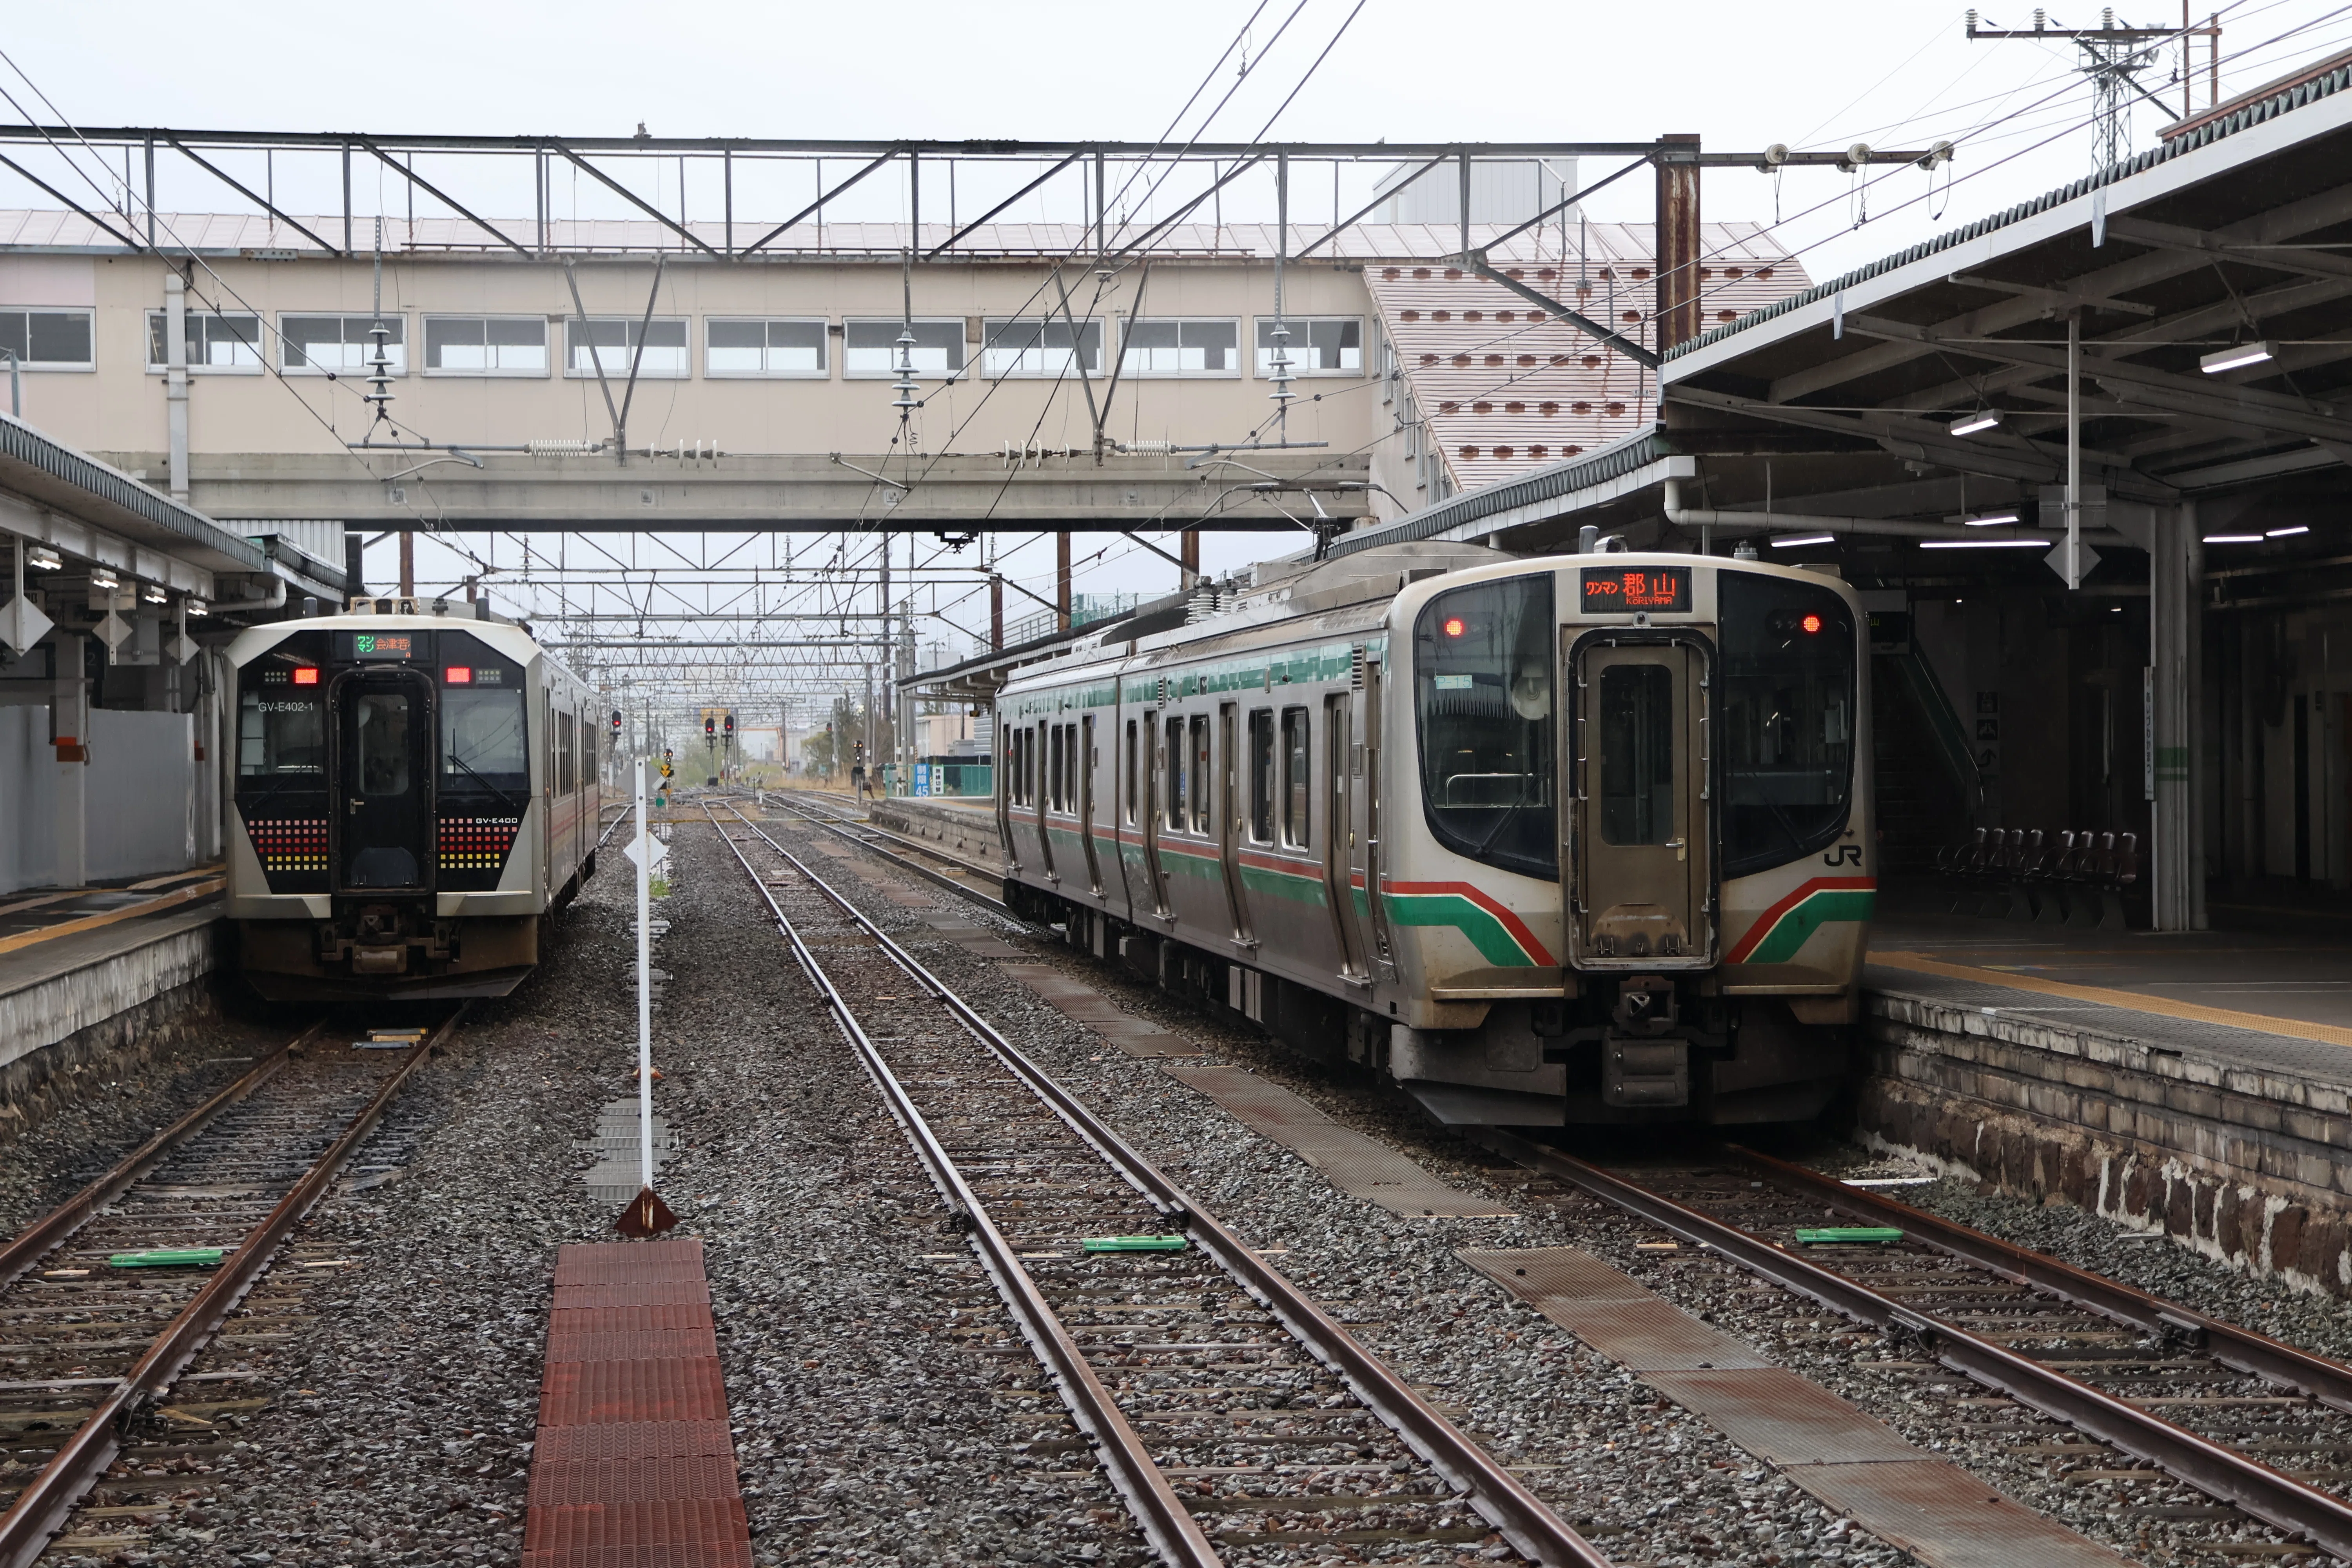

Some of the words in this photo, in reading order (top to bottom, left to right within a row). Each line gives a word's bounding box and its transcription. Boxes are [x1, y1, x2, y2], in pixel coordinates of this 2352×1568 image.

[1586, 582, 1618, 595] ワンマン
[1622, 573, 1675, 596] 郡山
[376, 638, 410, 650] 会津若
[1437, 676, 1471, 688] P-15
[258, 702, 312, 712] GV-E402-1
[916, 785, 928, 797] 45
[1824, 845, 1862, 867] JR
